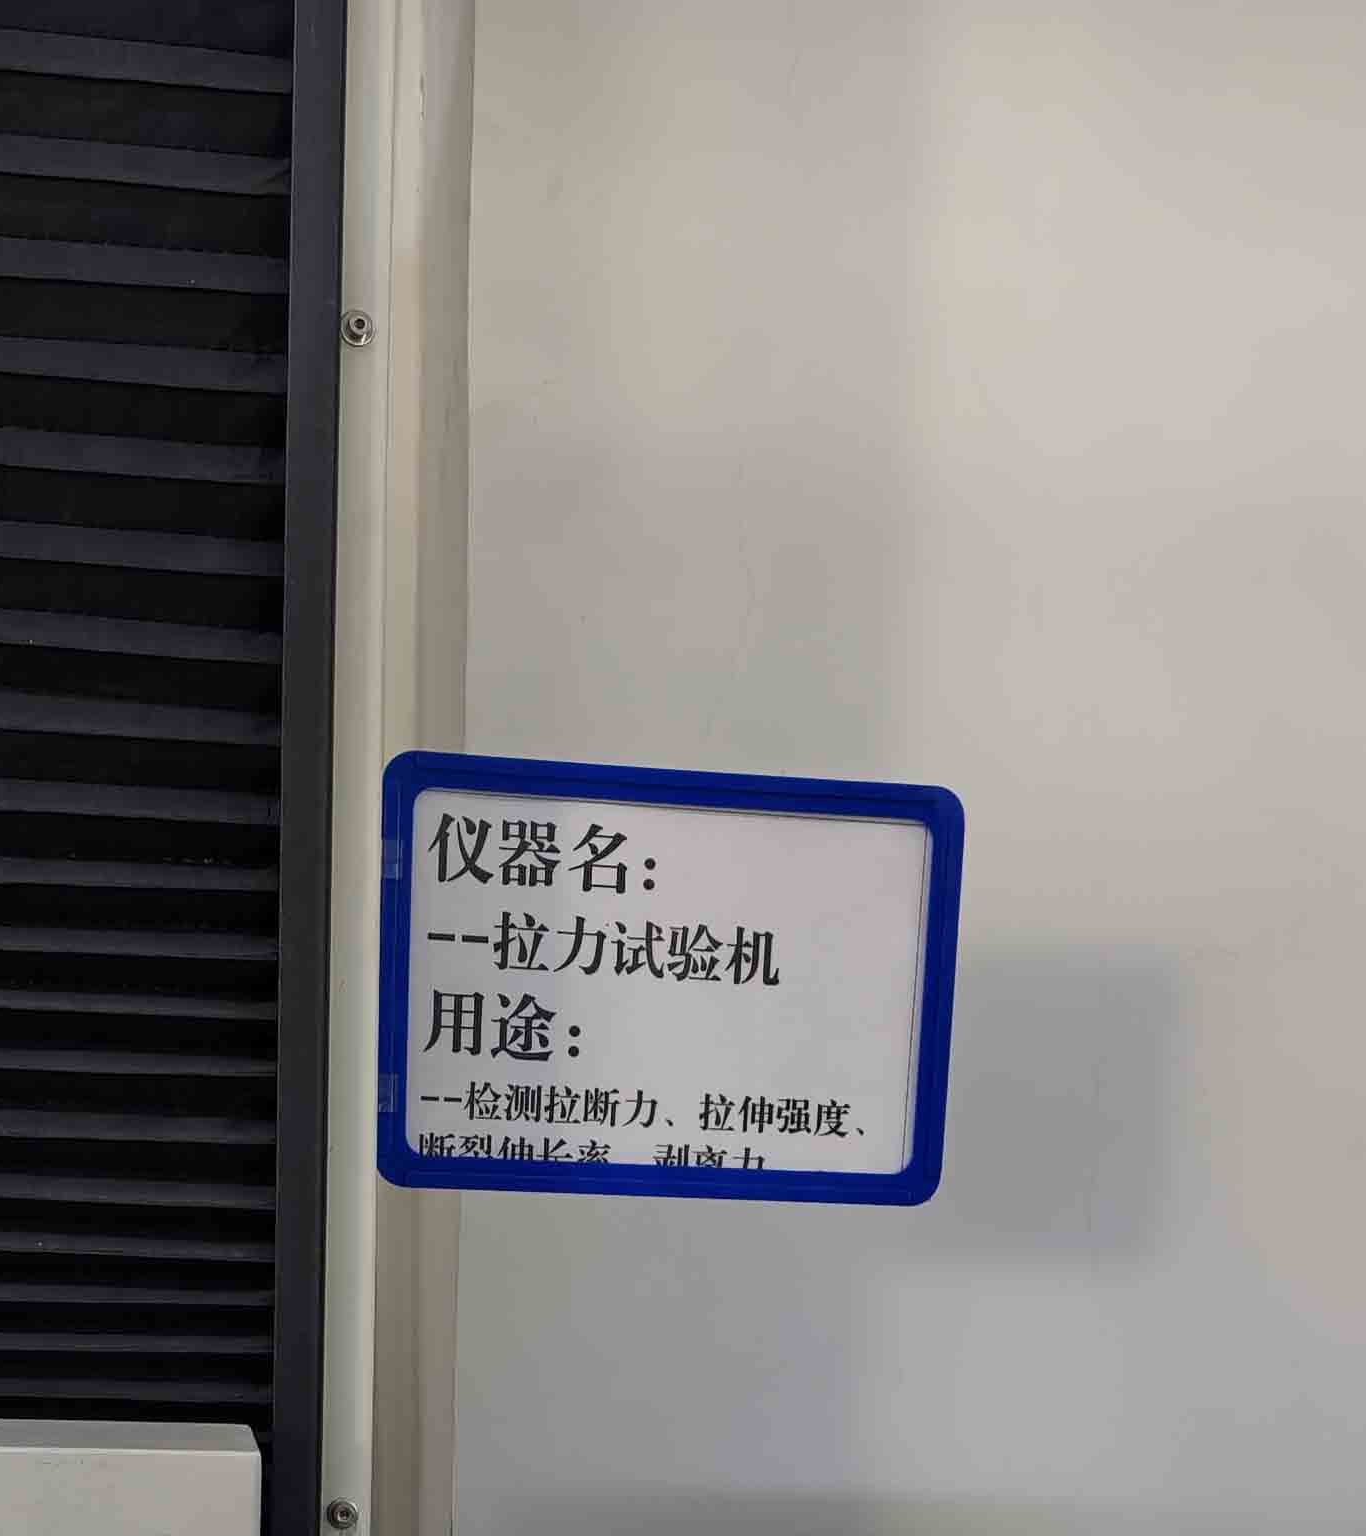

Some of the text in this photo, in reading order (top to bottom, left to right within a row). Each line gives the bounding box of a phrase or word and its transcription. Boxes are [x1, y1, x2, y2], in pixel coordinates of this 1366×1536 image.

[427, 813, 657, 894] 仪器名：
[427, 911, 780, 986] --拉力试验机
[423, 990, 582, 1061] 用途：
